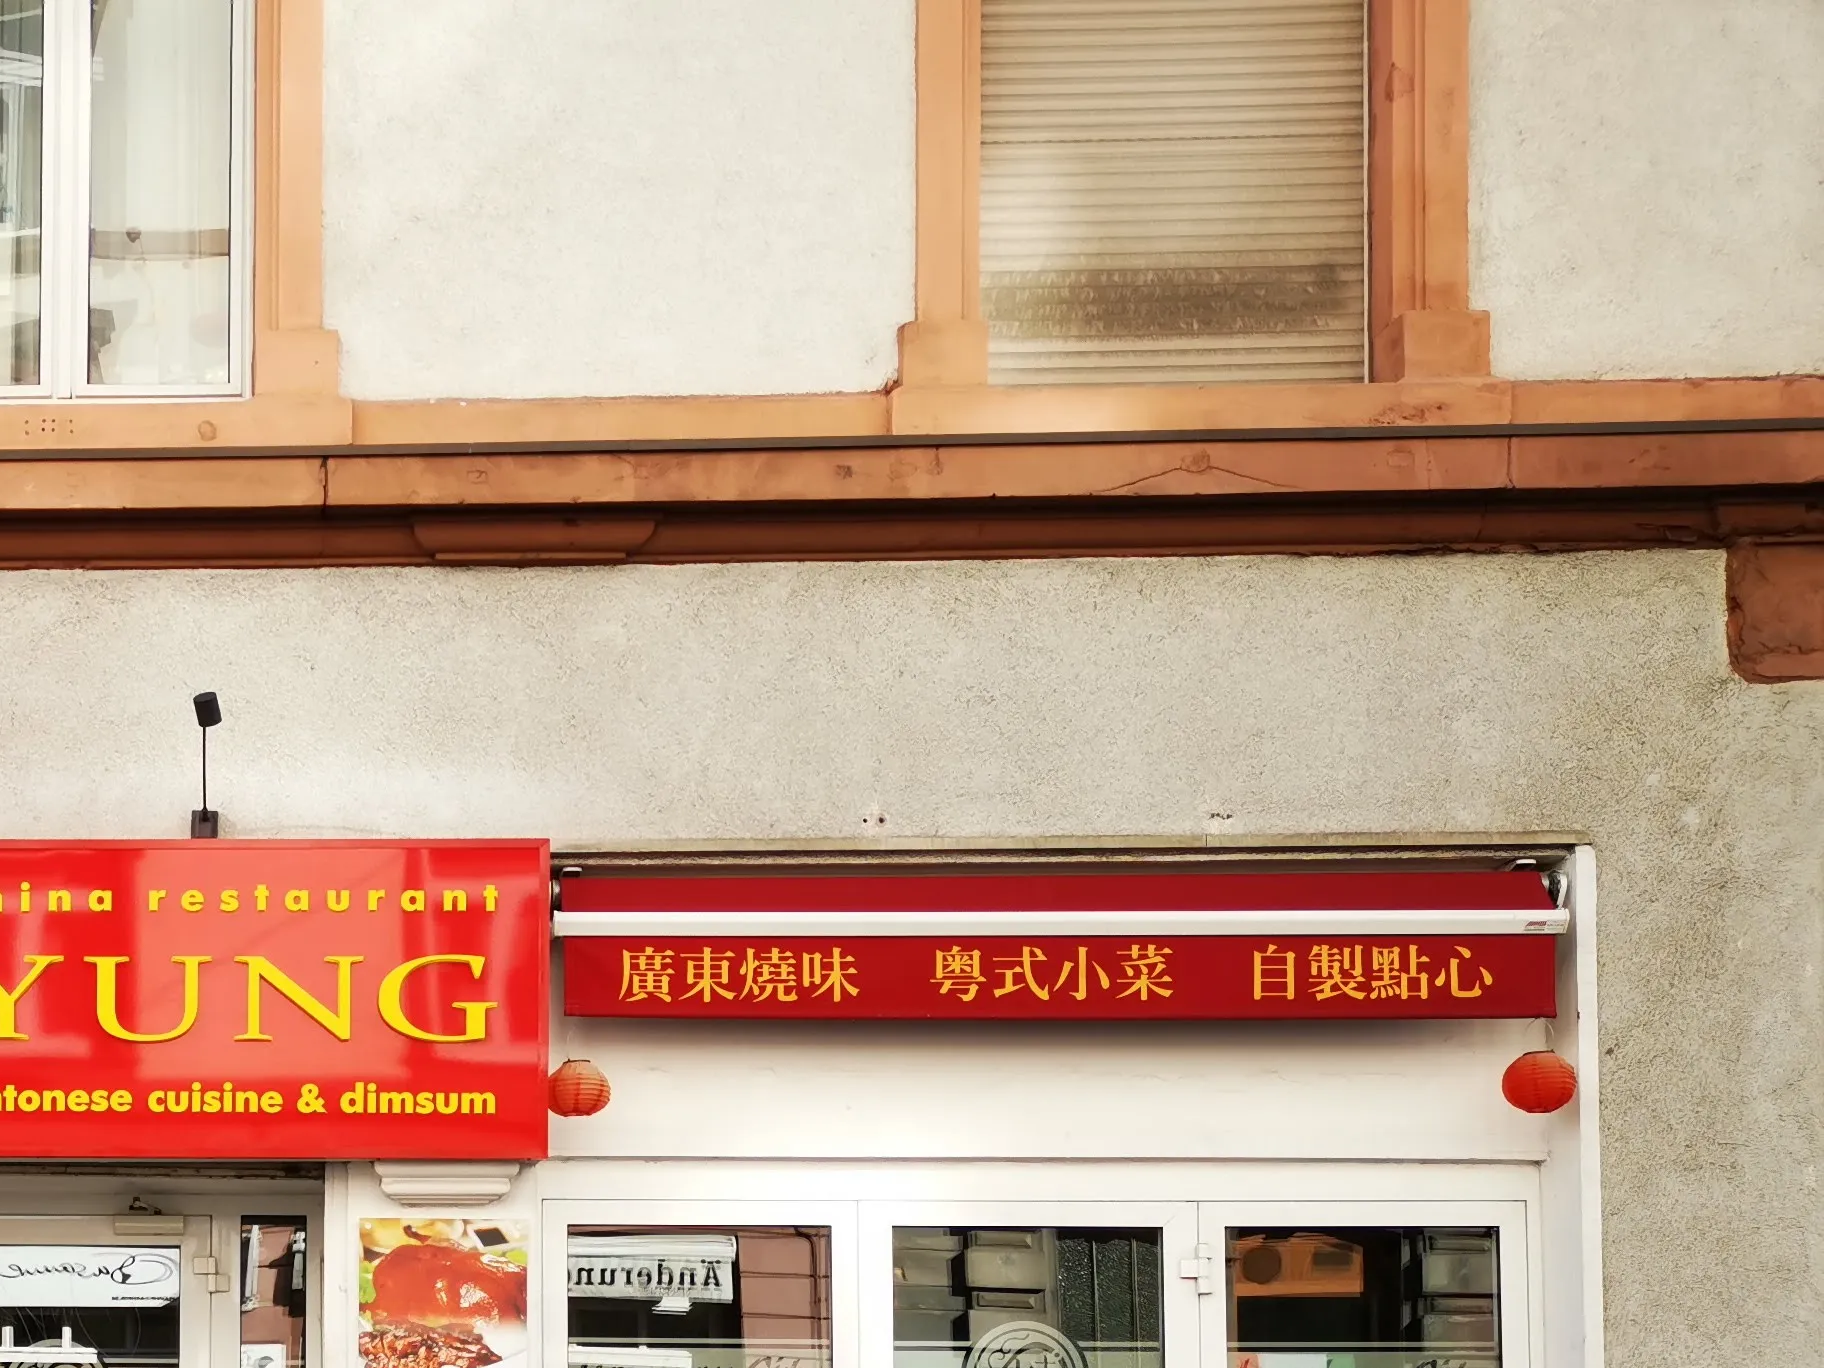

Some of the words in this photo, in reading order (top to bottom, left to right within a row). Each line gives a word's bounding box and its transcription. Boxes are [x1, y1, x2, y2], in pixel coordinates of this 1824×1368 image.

[148, 884, 499, 912] restaurant
[619, 946, 860, 1003] 廣東燒味
[1253, 944, 1493, 1001] 自製點心
[147, 1082, 283, 1114] cuisine
[297, 1083, 327, 1114] &
[339, 1081, 497, 1114] dimsum
